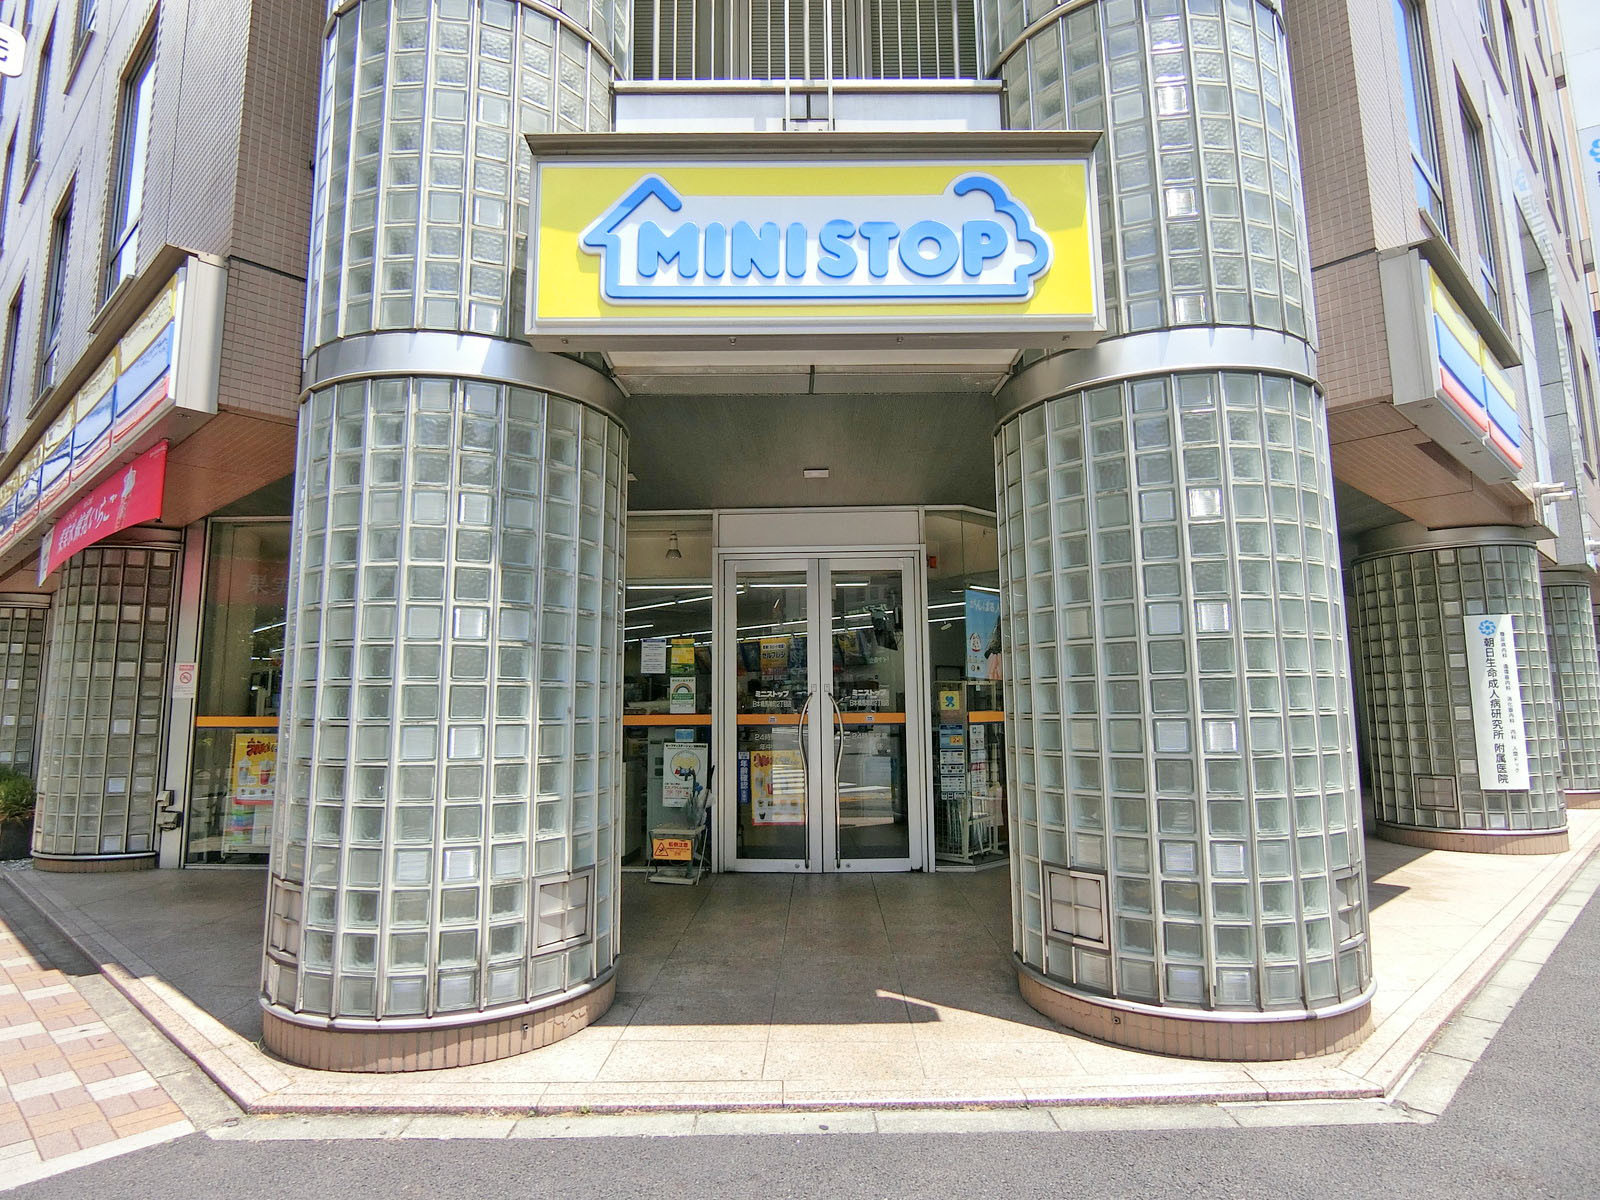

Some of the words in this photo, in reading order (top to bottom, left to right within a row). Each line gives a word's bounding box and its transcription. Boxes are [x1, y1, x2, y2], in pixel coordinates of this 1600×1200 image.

[636, 218, 1009, 279] MINISTOP
[754, 690, 790, 698] ミニストップ
[1483, 637, 1505, 740] 朝日生命成人病研究所
[1494, 743, 1510, 785] 附属医院
